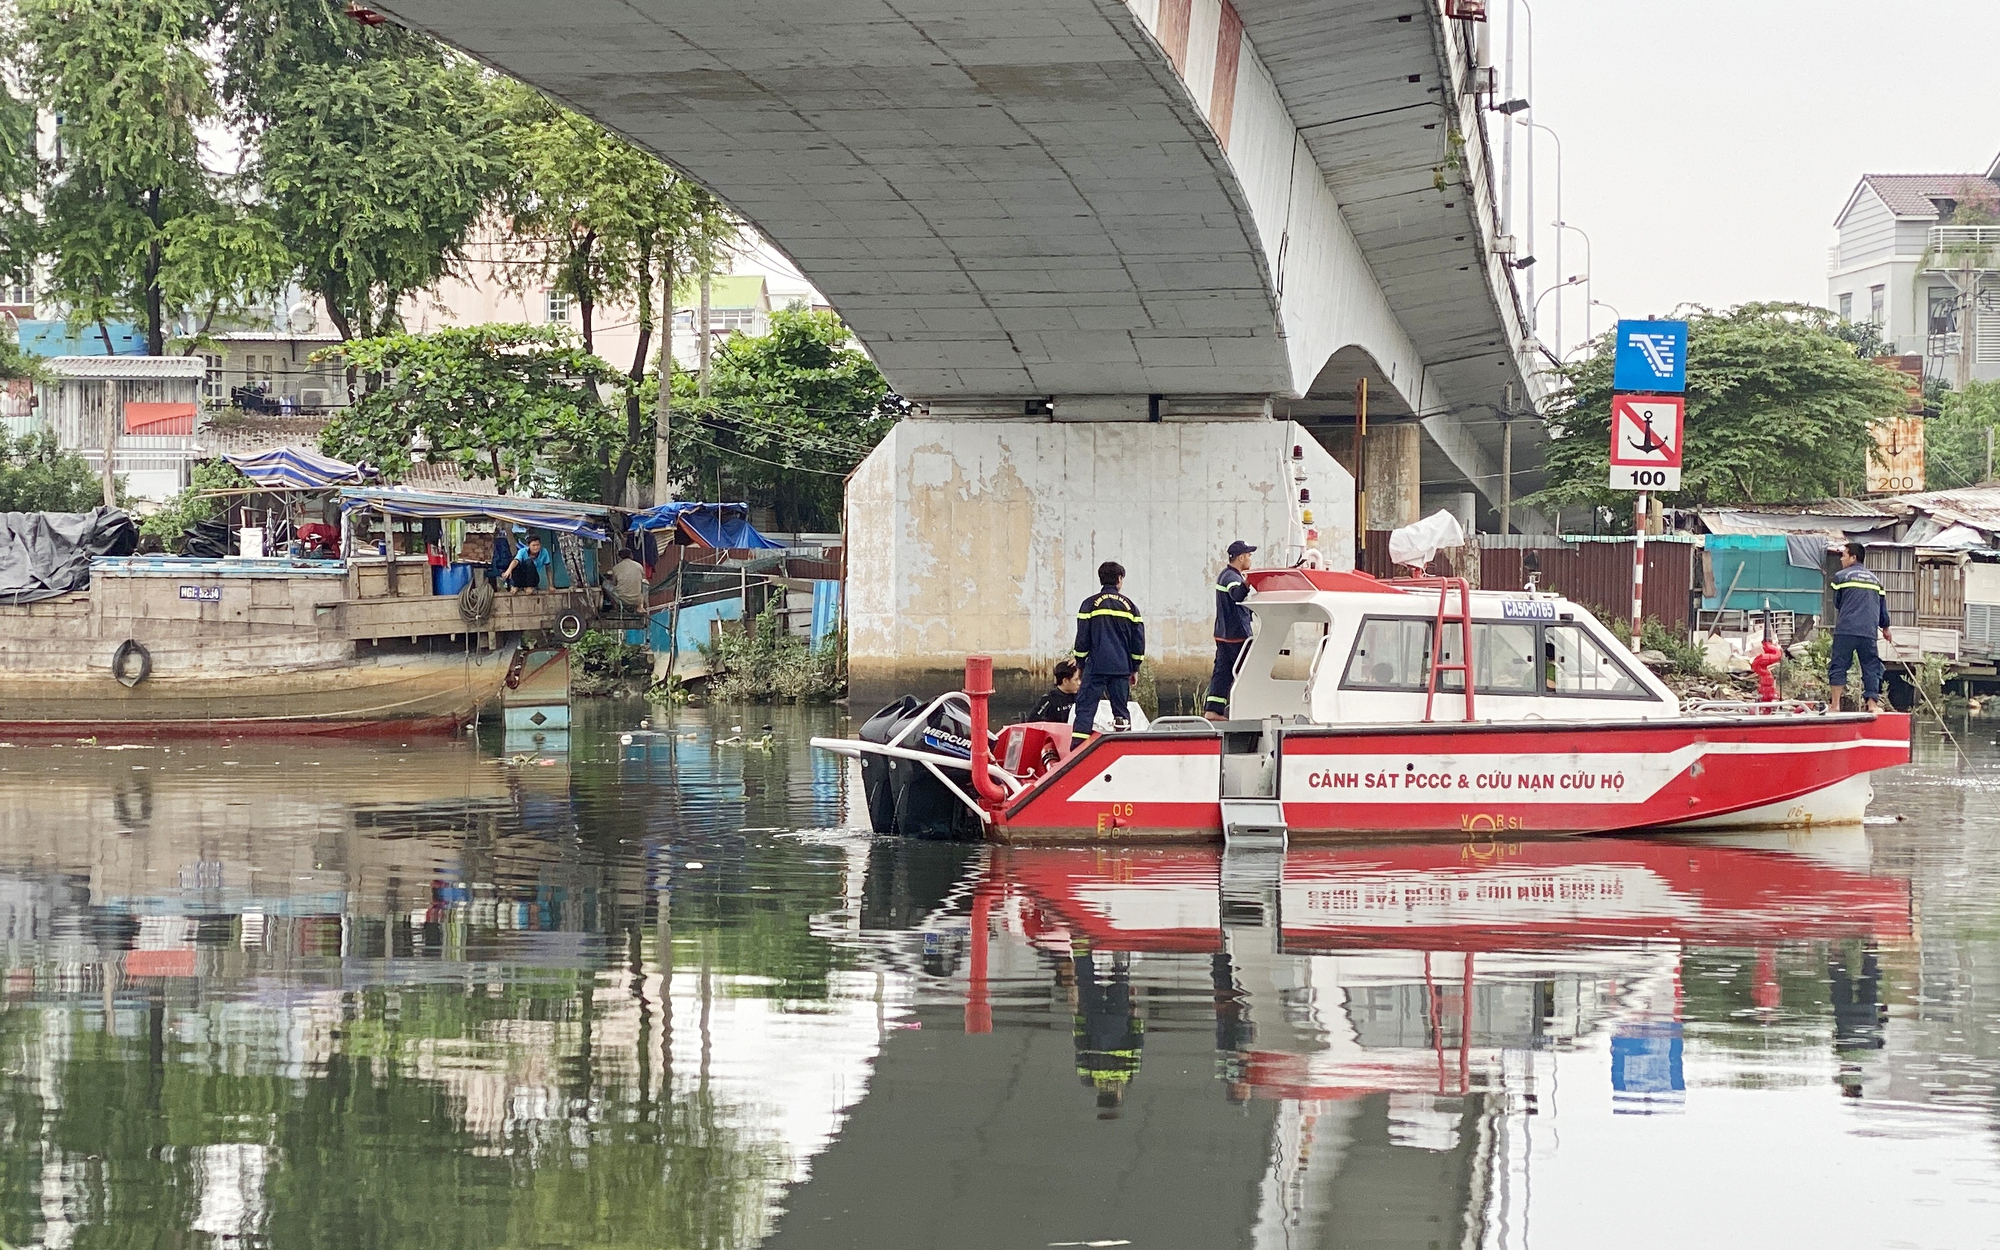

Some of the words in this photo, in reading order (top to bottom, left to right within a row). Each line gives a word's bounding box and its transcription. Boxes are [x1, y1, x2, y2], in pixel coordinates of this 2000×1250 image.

[1630, 470, 1666, 486] 100
[1878, 476, 1914, 490] 200
[1504, 601, 1553, 618] CA50-0165
[922, 725, 972, 749] MERCUR
[1308, 768, 1359, 789] CẢNH
[1364, 769, 1400, 789] SÁT
[1404, 773, 1452, 789] PCCC
[1457, 773, 1470, 789] &
[1476, 769, 1512, 790] CỨU
[1517, 774, 1555, 793] NẠN
[1559, 769, 1596, 790] CỨU
[1600, 770, 1625, 793] HỘ
[1112, 803, 1133, 817] 06
